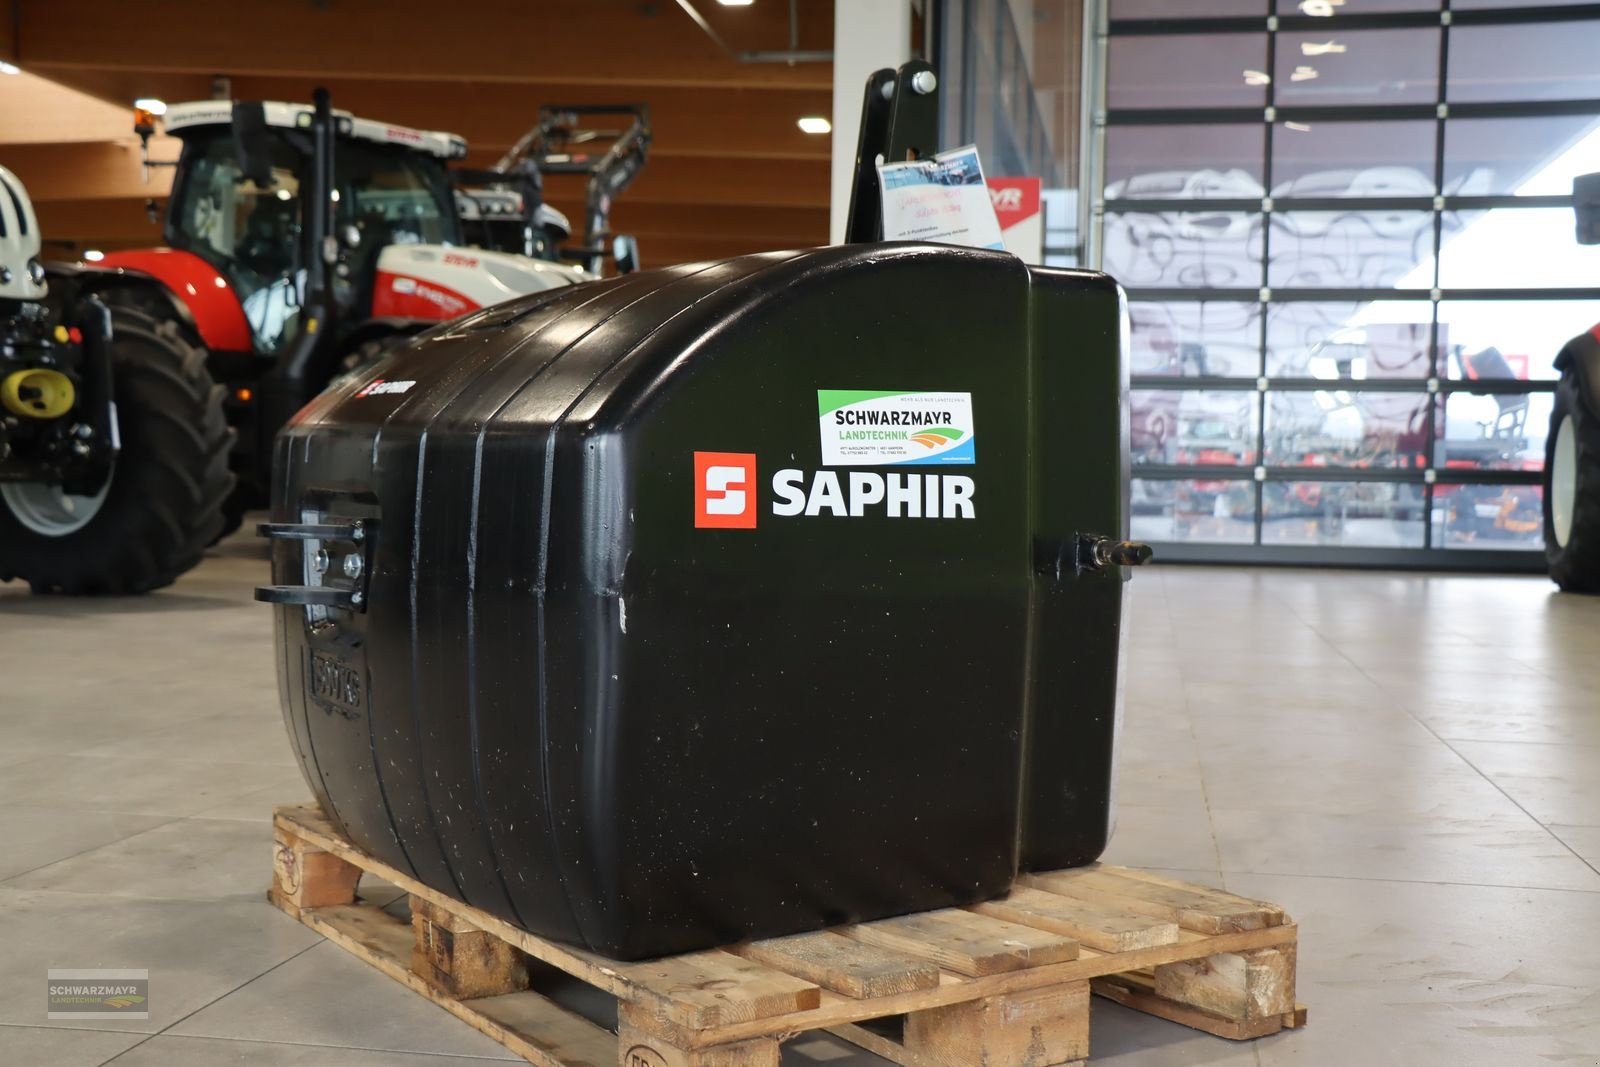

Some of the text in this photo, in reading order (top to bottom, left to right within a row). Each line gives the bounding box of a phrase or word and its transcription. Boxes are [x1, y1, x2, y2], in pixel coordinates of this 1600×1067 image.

[835, 410, 952, 426] SCHWARZMAYR
[839, 430, 909, 441] LANDTECHNIK
[772, 469, 976, 520] SAPHIR
